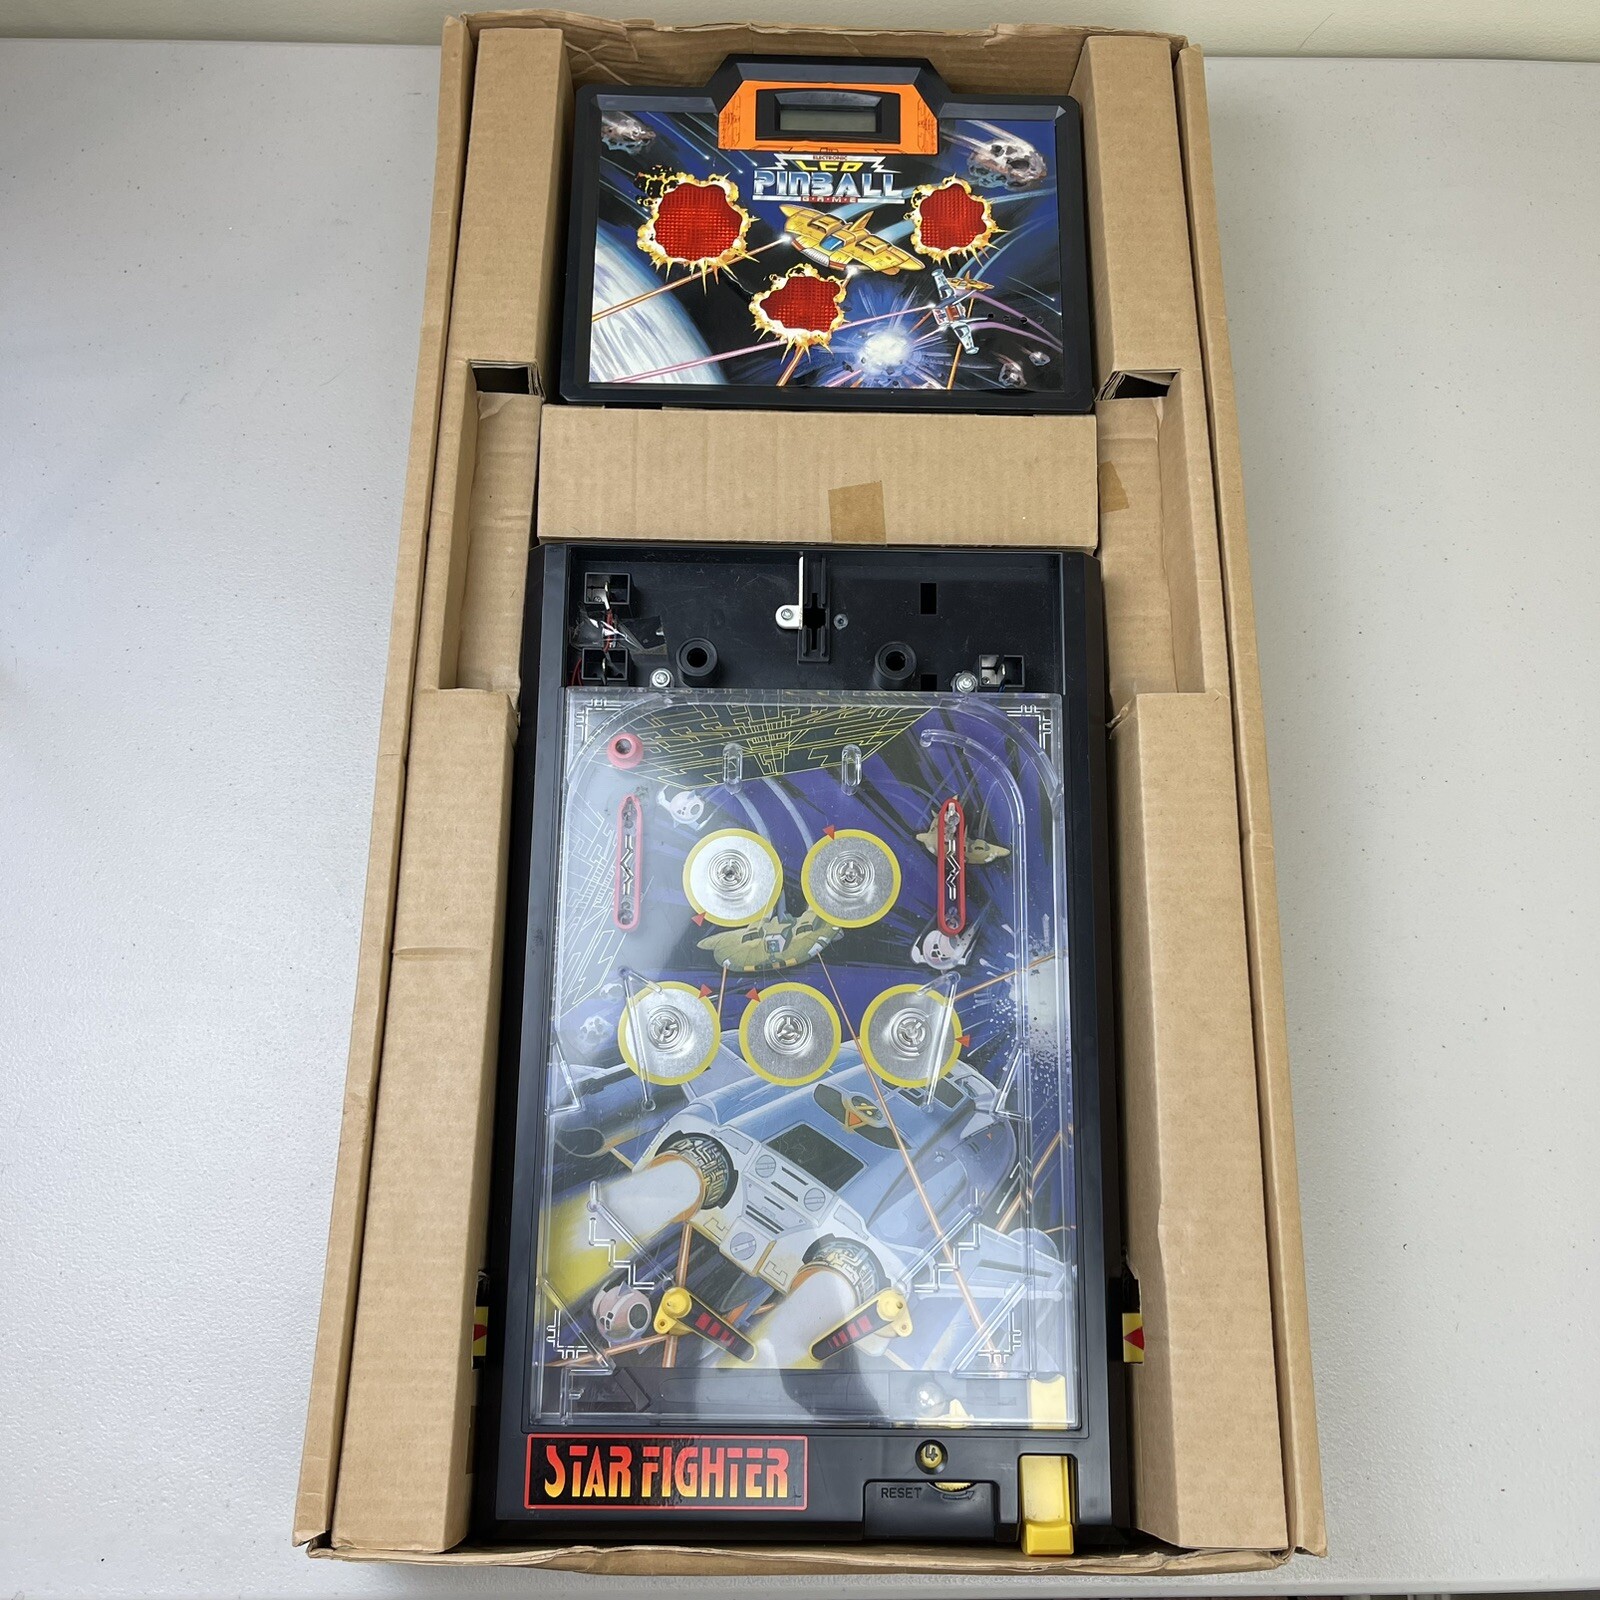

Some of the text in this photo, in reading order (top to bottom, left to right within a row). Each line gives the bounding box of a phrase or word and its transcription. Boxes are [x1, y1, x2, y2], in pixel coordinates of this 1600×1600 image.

[795, 160, 864, 172] LCD
[753, 170, 905, 198] PINBALL
[544, 1445, 789, 1499] STAR FIGHTER
[881, 1487, 922, 1499] RESET
